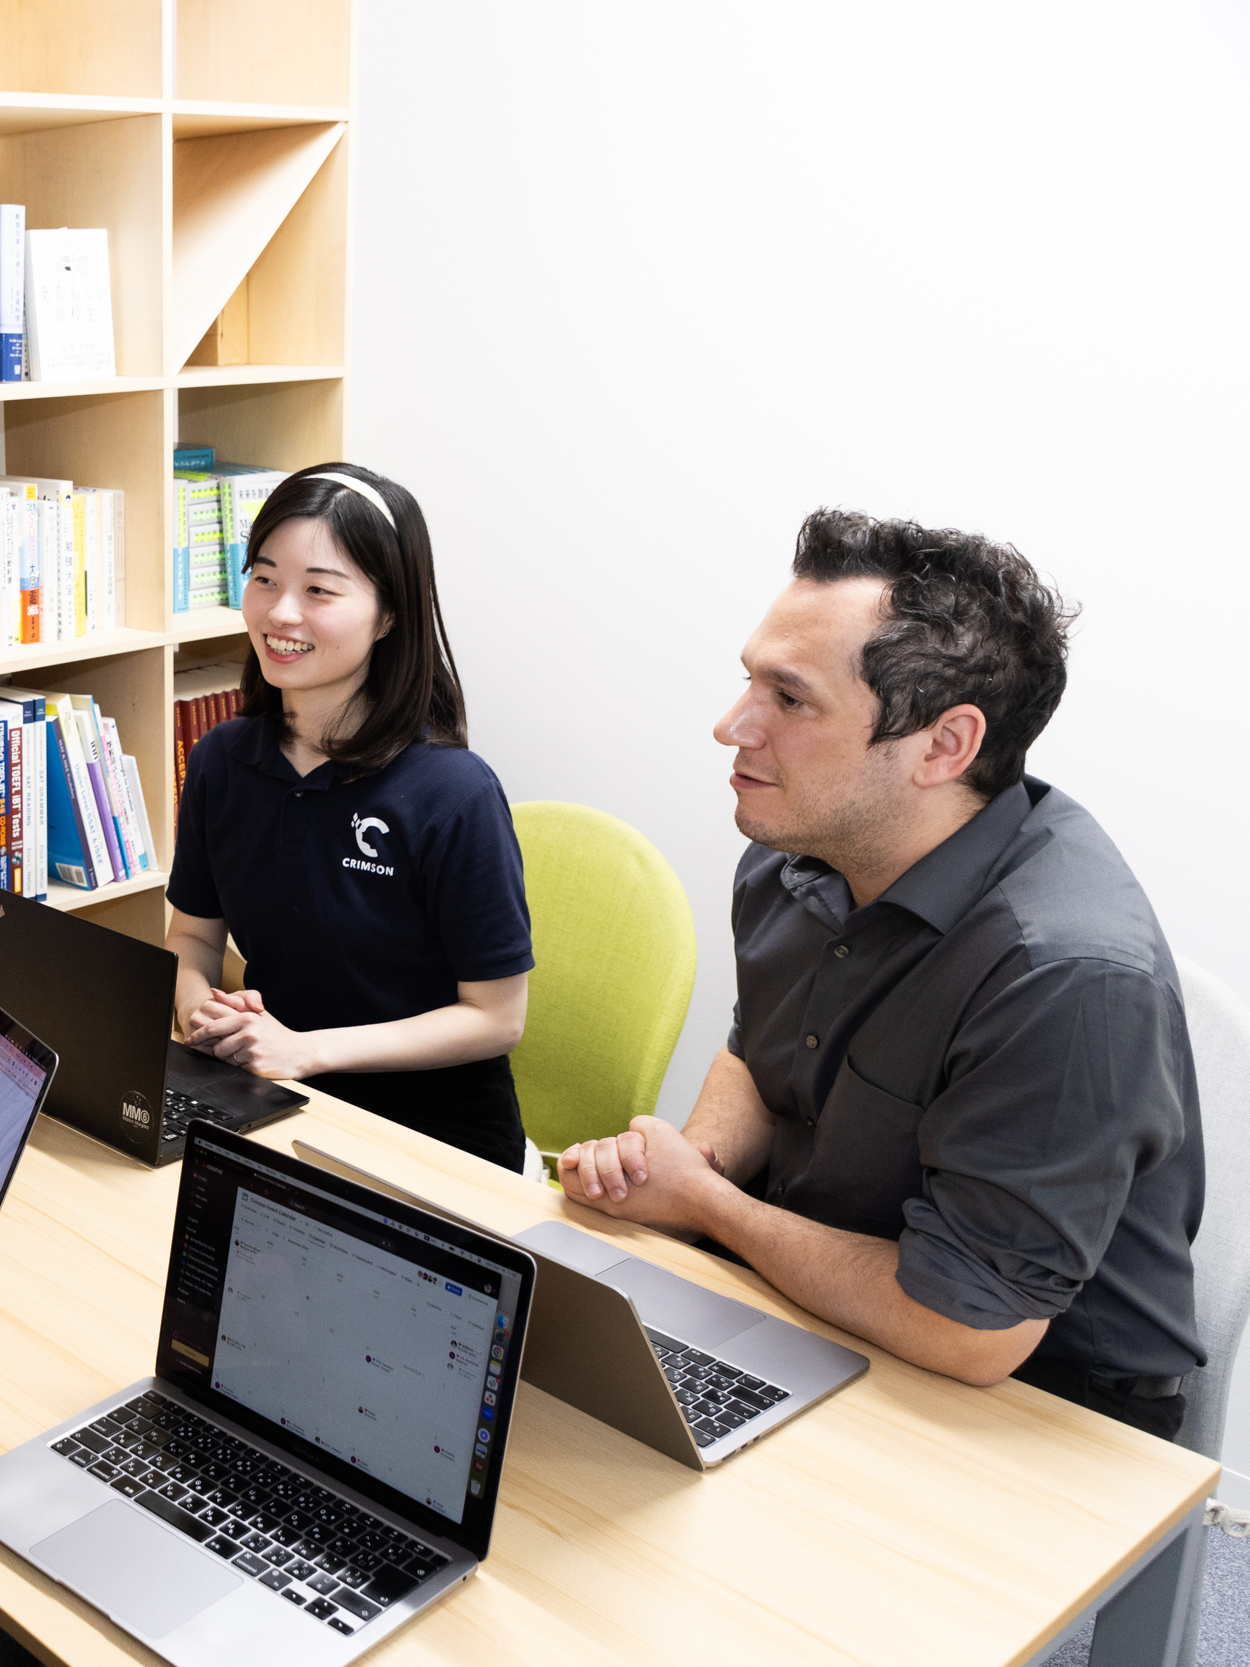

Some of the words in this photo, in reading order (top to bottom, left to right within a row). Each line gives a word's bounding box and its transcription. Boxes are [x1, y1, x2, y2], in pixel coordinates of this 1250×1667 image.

[75, 763, 84, 786] Upper
[80, 788, 89, 811] Level
[86, 811, 96, 835] SSAT
[92, 835, 98, 843] &
[93, 844, 103, 866] ISEE
[342, 857, 394, 877] CRIMSON
[206, 1163, 223, 1175] asana
[250, 1197, 267, 1210] Crimson
[267, 1204, 279, 1214] Event
[278, 1209, 297, 1222] Calendar
[74, 1455, 87, 1465] option
[91, 1466, 111, 1480] command
[236, 1558, 258, 1573] command
